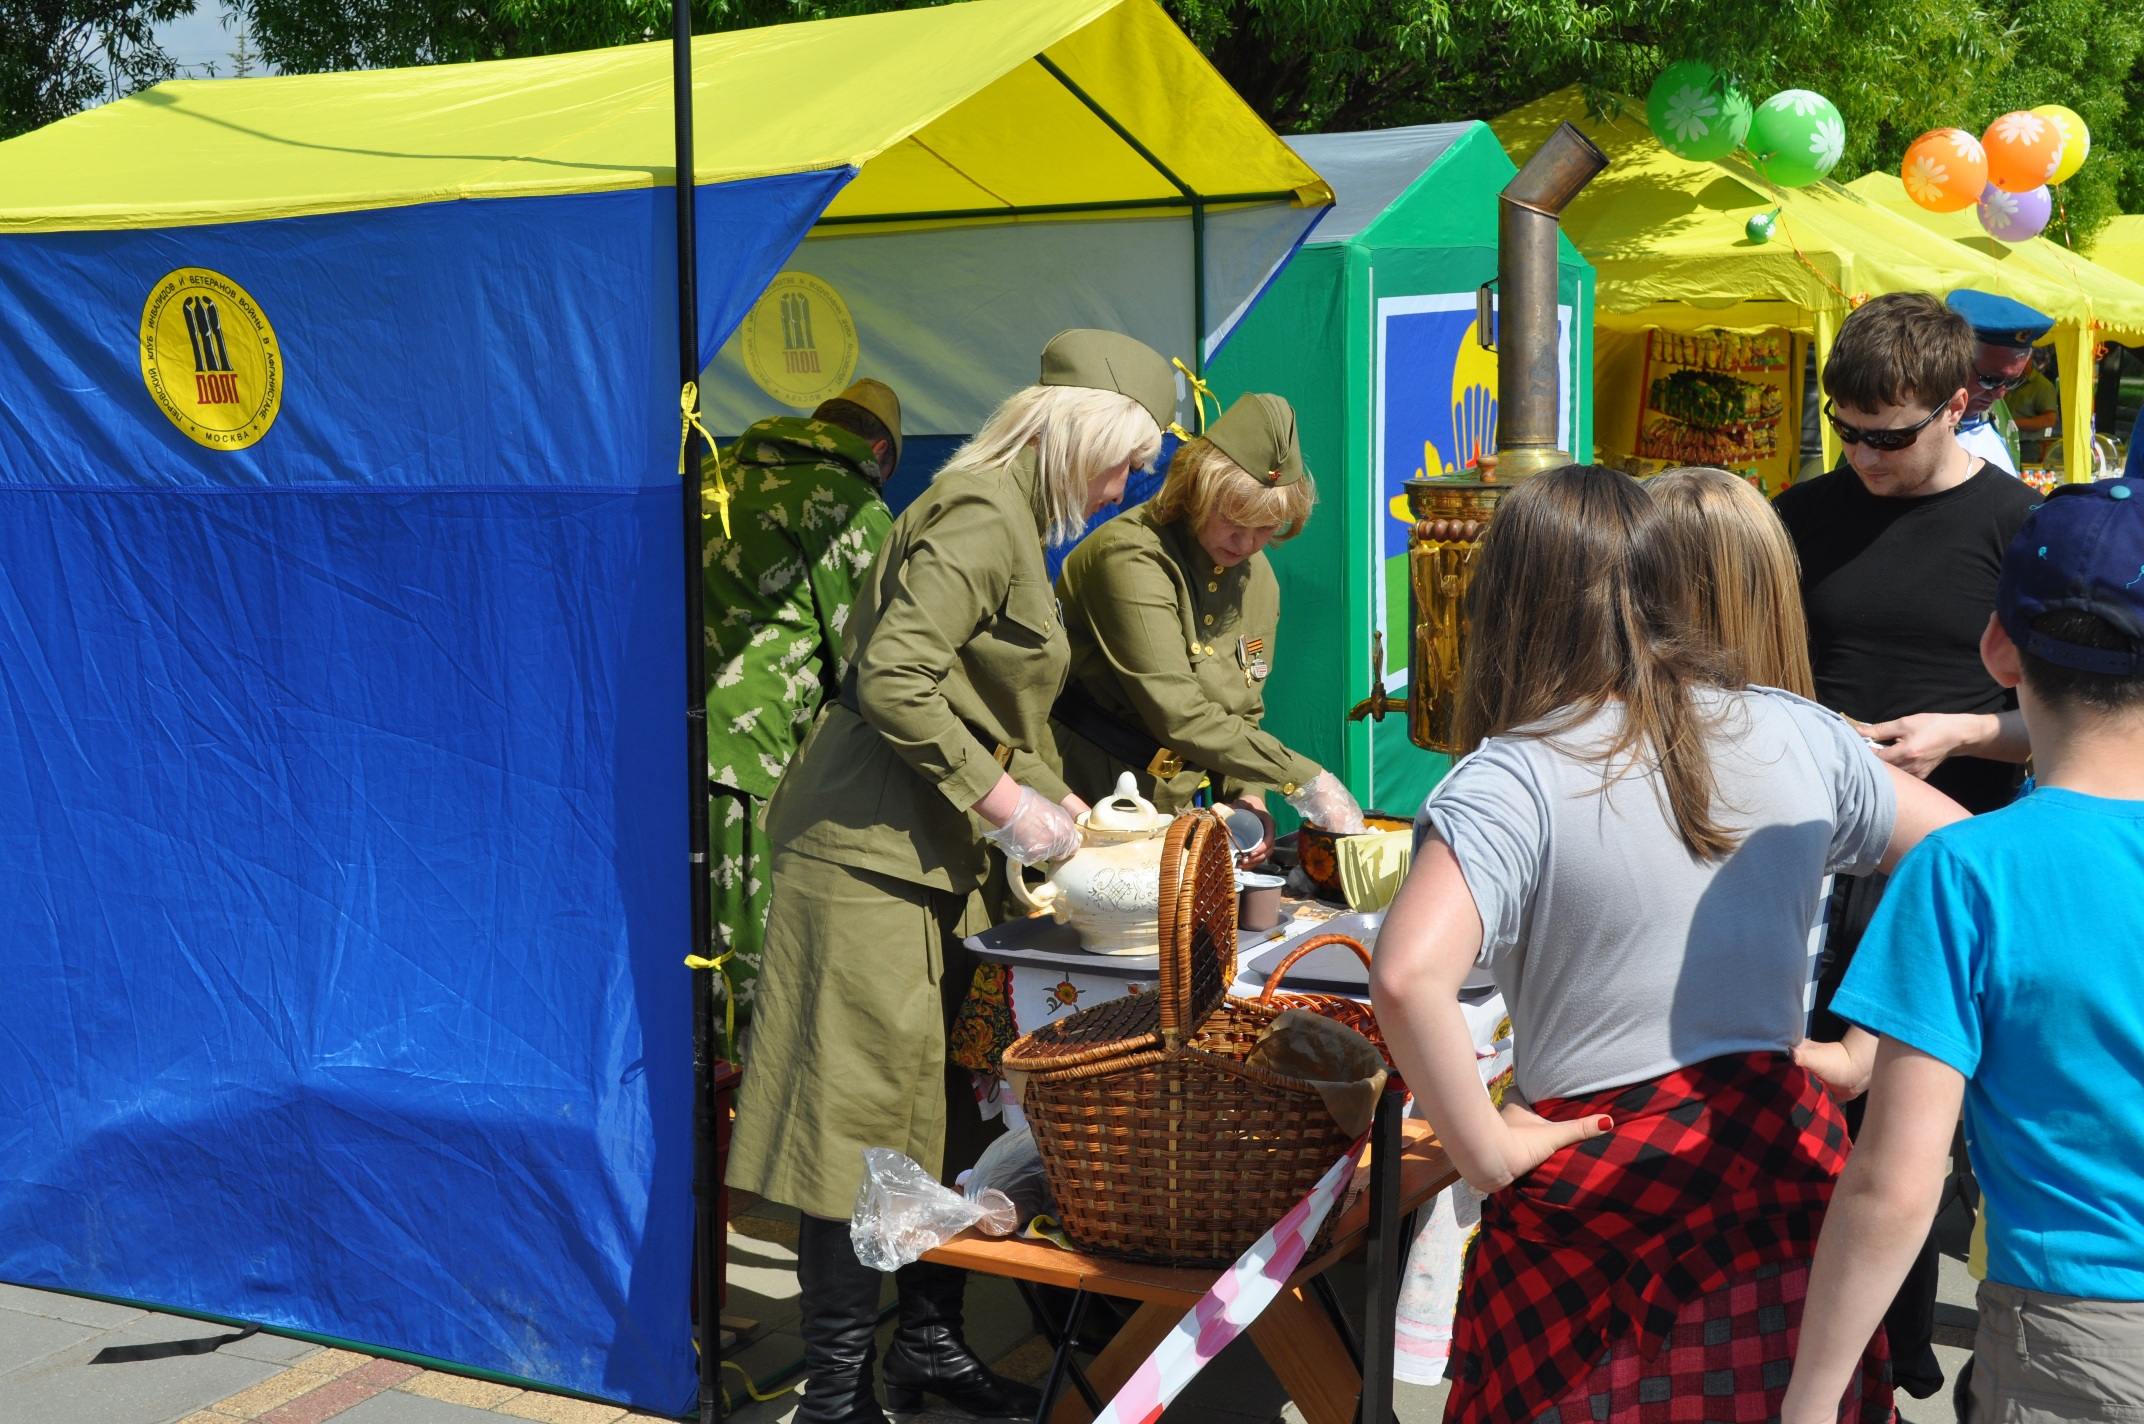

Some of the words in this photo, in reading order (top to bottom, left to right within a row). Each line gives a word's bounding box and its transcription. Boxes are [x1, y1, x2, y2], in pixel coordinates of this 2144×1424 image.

[178, 276, 186, 287] И
[189, 275, 237, 299] ВЕТЕРАНОВ
[148, 282, 176, 329] ИНВАЛИДОВ
[238, 297, 264, 331] ВОЙНЫ
[146, 335, 154, 360] КЛУБ
[262, 337, 270, 345] В
[148, 367, 183, 422] ПЕРОВСКИЙ
[195, 374, 240, 405] ДОЛГ
[259, 351, 276, 421] АФГАНИСТАНЕ
[205, 430, 250, 443] МОСКВА
